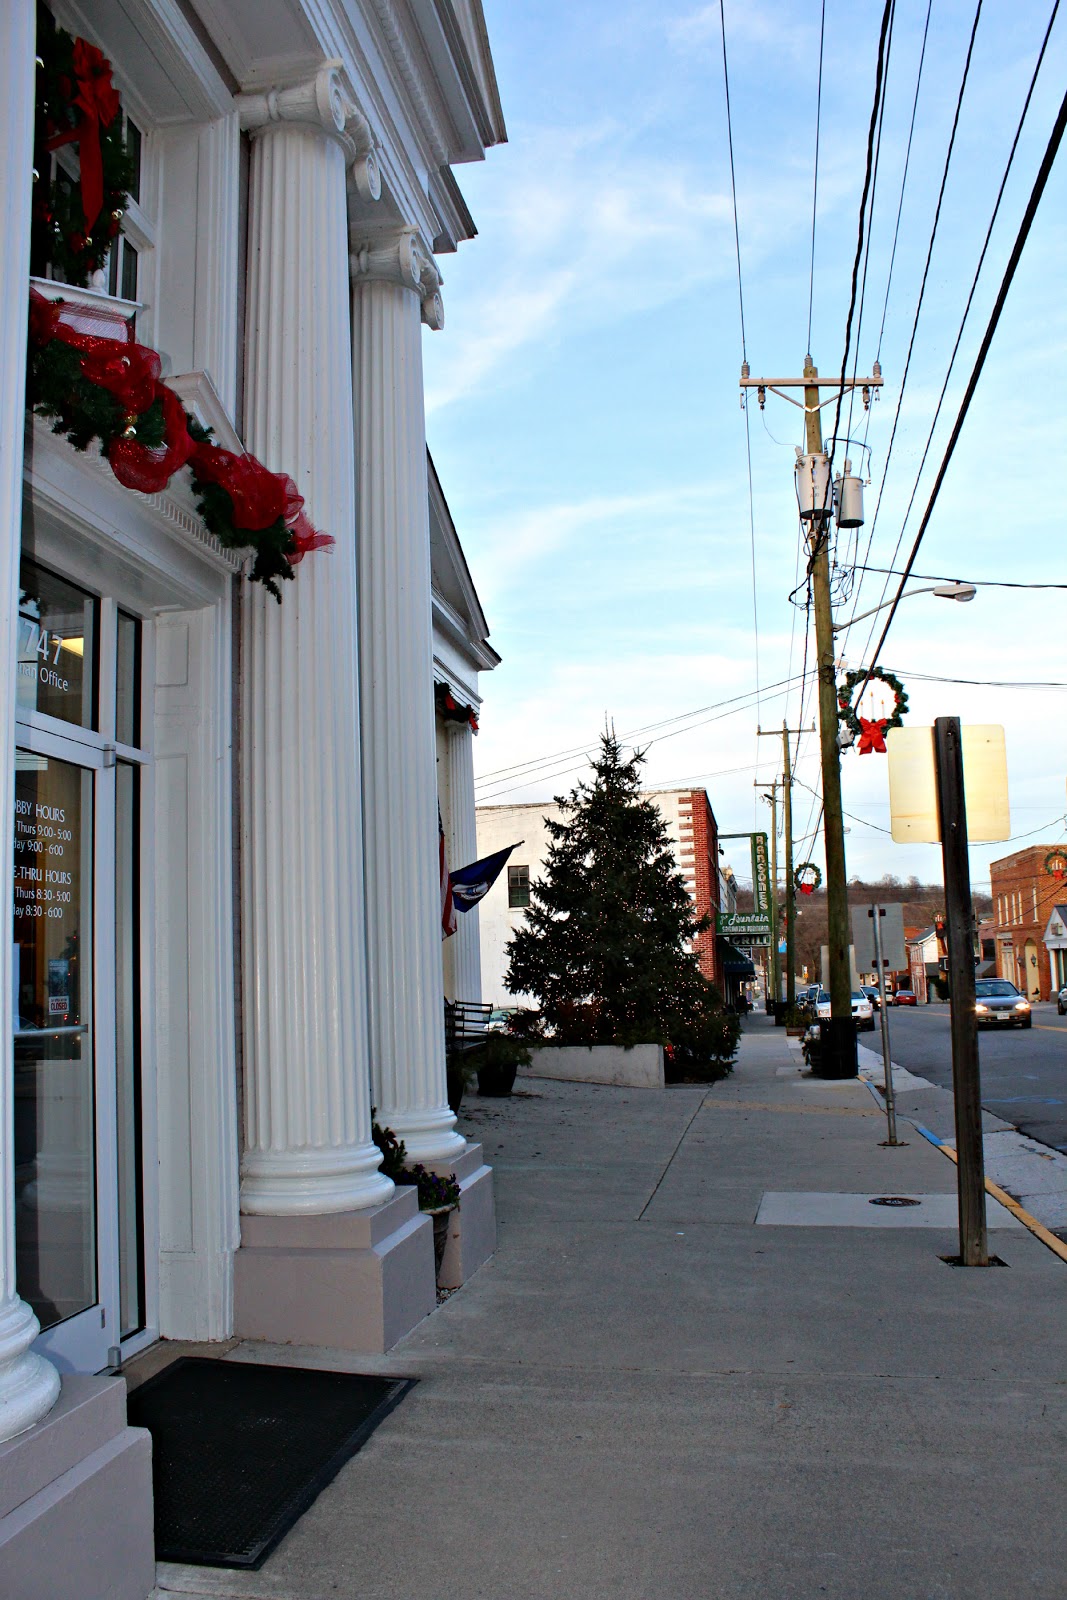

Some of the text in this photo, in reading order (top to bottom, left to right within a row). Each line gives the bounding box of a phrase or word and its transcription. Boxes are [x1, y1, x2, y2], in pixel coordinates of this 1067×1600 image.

[23, 621, 63, 665] 747
[40, 667, 69, 692] Office
[14, 799, 65, 823] BBY HOURS
[16, 820, 36, 835] Thurs
[27, 840, 43, 853] 9:00
[45, 869, 72, 885] HOURS
[15, 886, 35, 900] Thurs
[25, 904, 43, 917] 8:30
[728, 913, 770, 926] Fountain
[732, 935, 770, 945] GRILL
[50, 1002, 68, 1011] CLOSED
